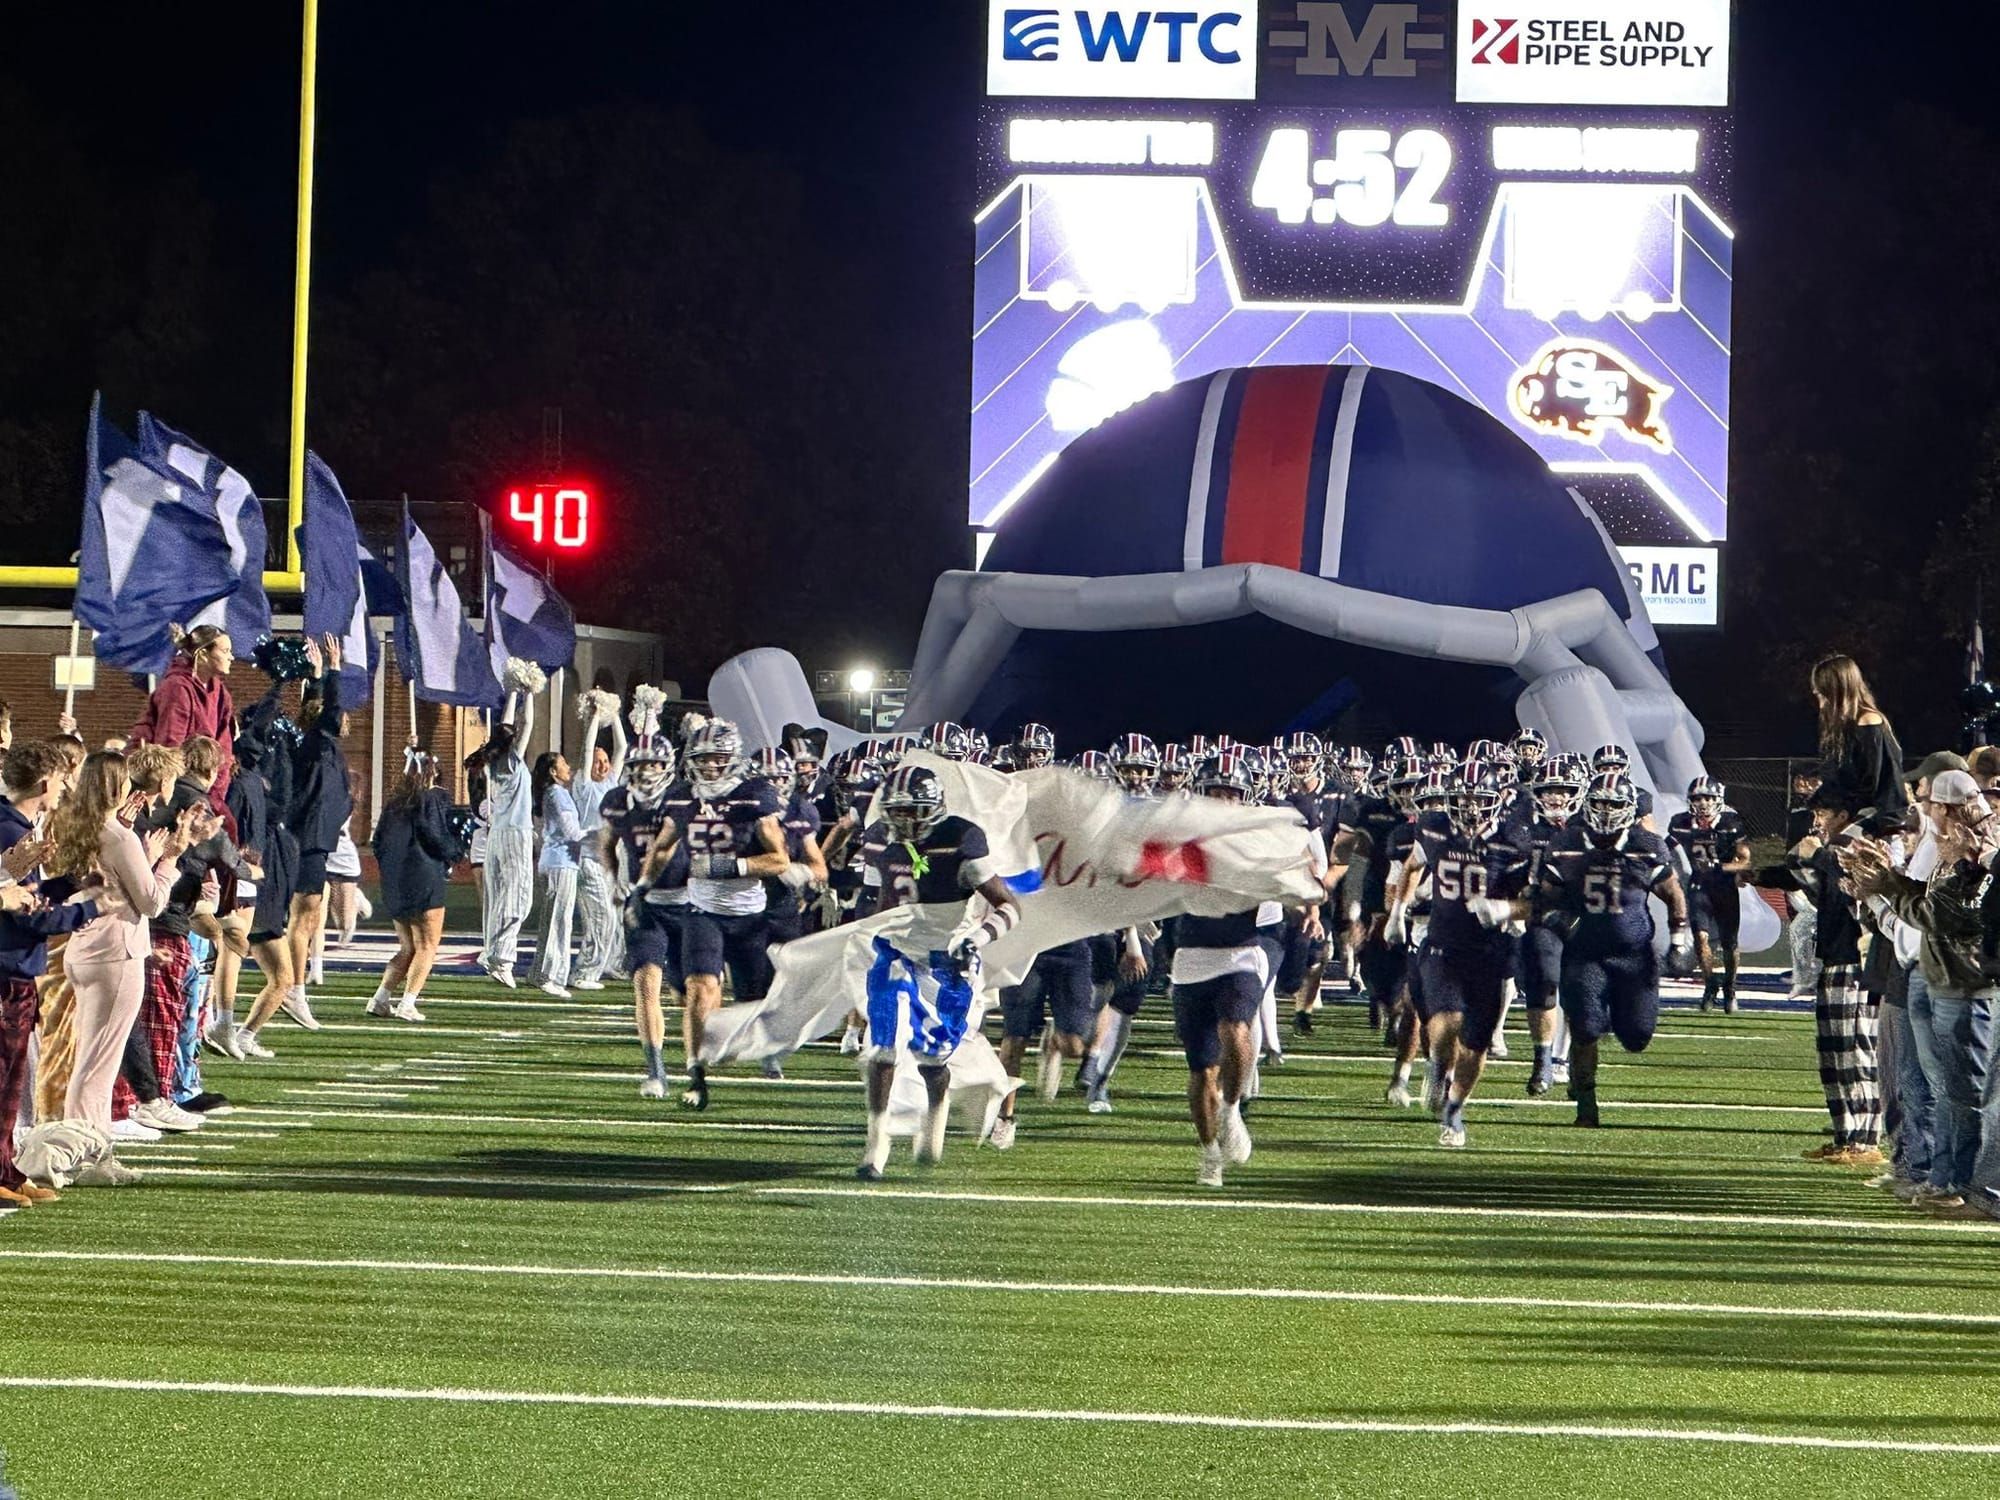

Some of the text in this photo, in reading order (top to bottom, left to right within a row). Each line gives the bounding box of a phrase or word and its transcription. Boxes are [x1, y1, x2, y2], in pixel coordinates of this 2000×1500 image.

[1074, 10, 1242, 65] WTC
[1296, 2, 1417, 77] M
[1527, 19, 1685, 43] STEEL AND
[1525, 44, 1713, 68] PIPE SUPPLY
[1252, 128, 1452, 227] 4:52
[510, 490, 587, 547] 40
[1437, 858, 1488, 900] 50
[1584, 874, 1624, 914] 51
